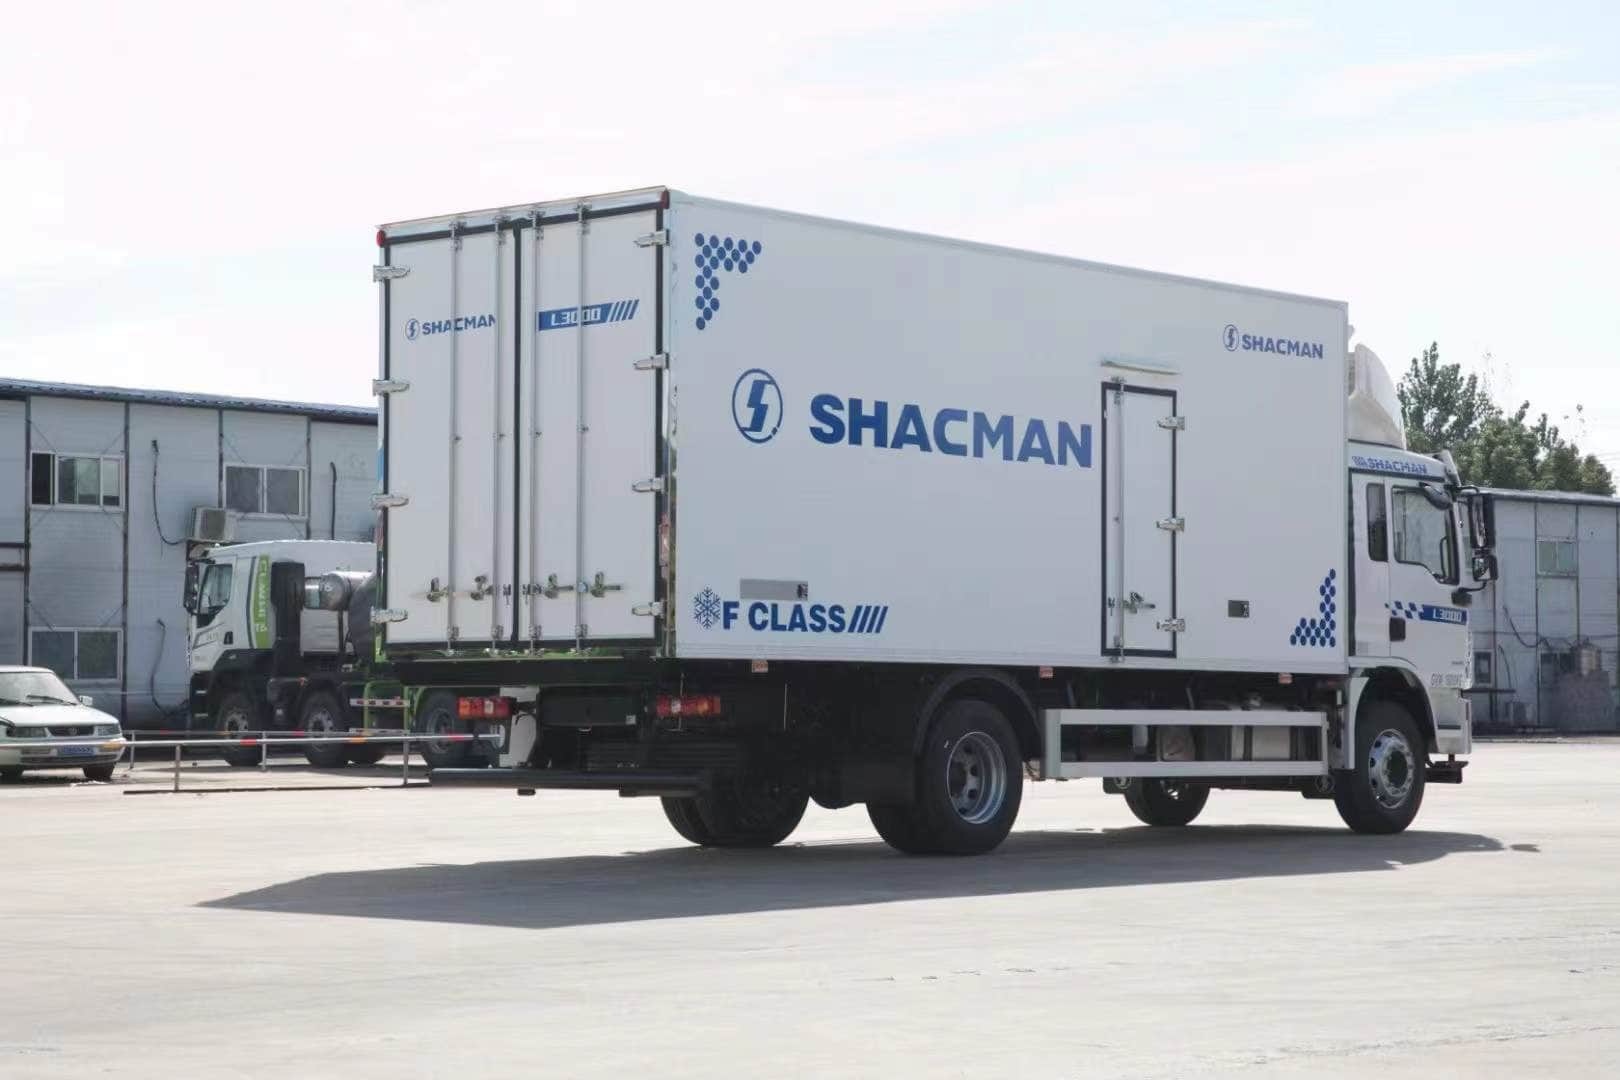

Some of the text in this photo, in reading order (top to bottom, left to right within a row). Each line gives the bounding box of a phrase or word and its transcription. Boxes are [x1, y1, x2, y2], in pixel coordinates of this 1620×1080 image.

[550, 306, 602, 326] L3000
[1241, 334, 1324, 359] SHACMAN
[809, 393, 1092, 468] SHACMAN
[1368, 458, 1427, 474] SHACMAN
[722, 601, 846, 633] F CLASS
[1432, 608, 1462, 623] L3000
